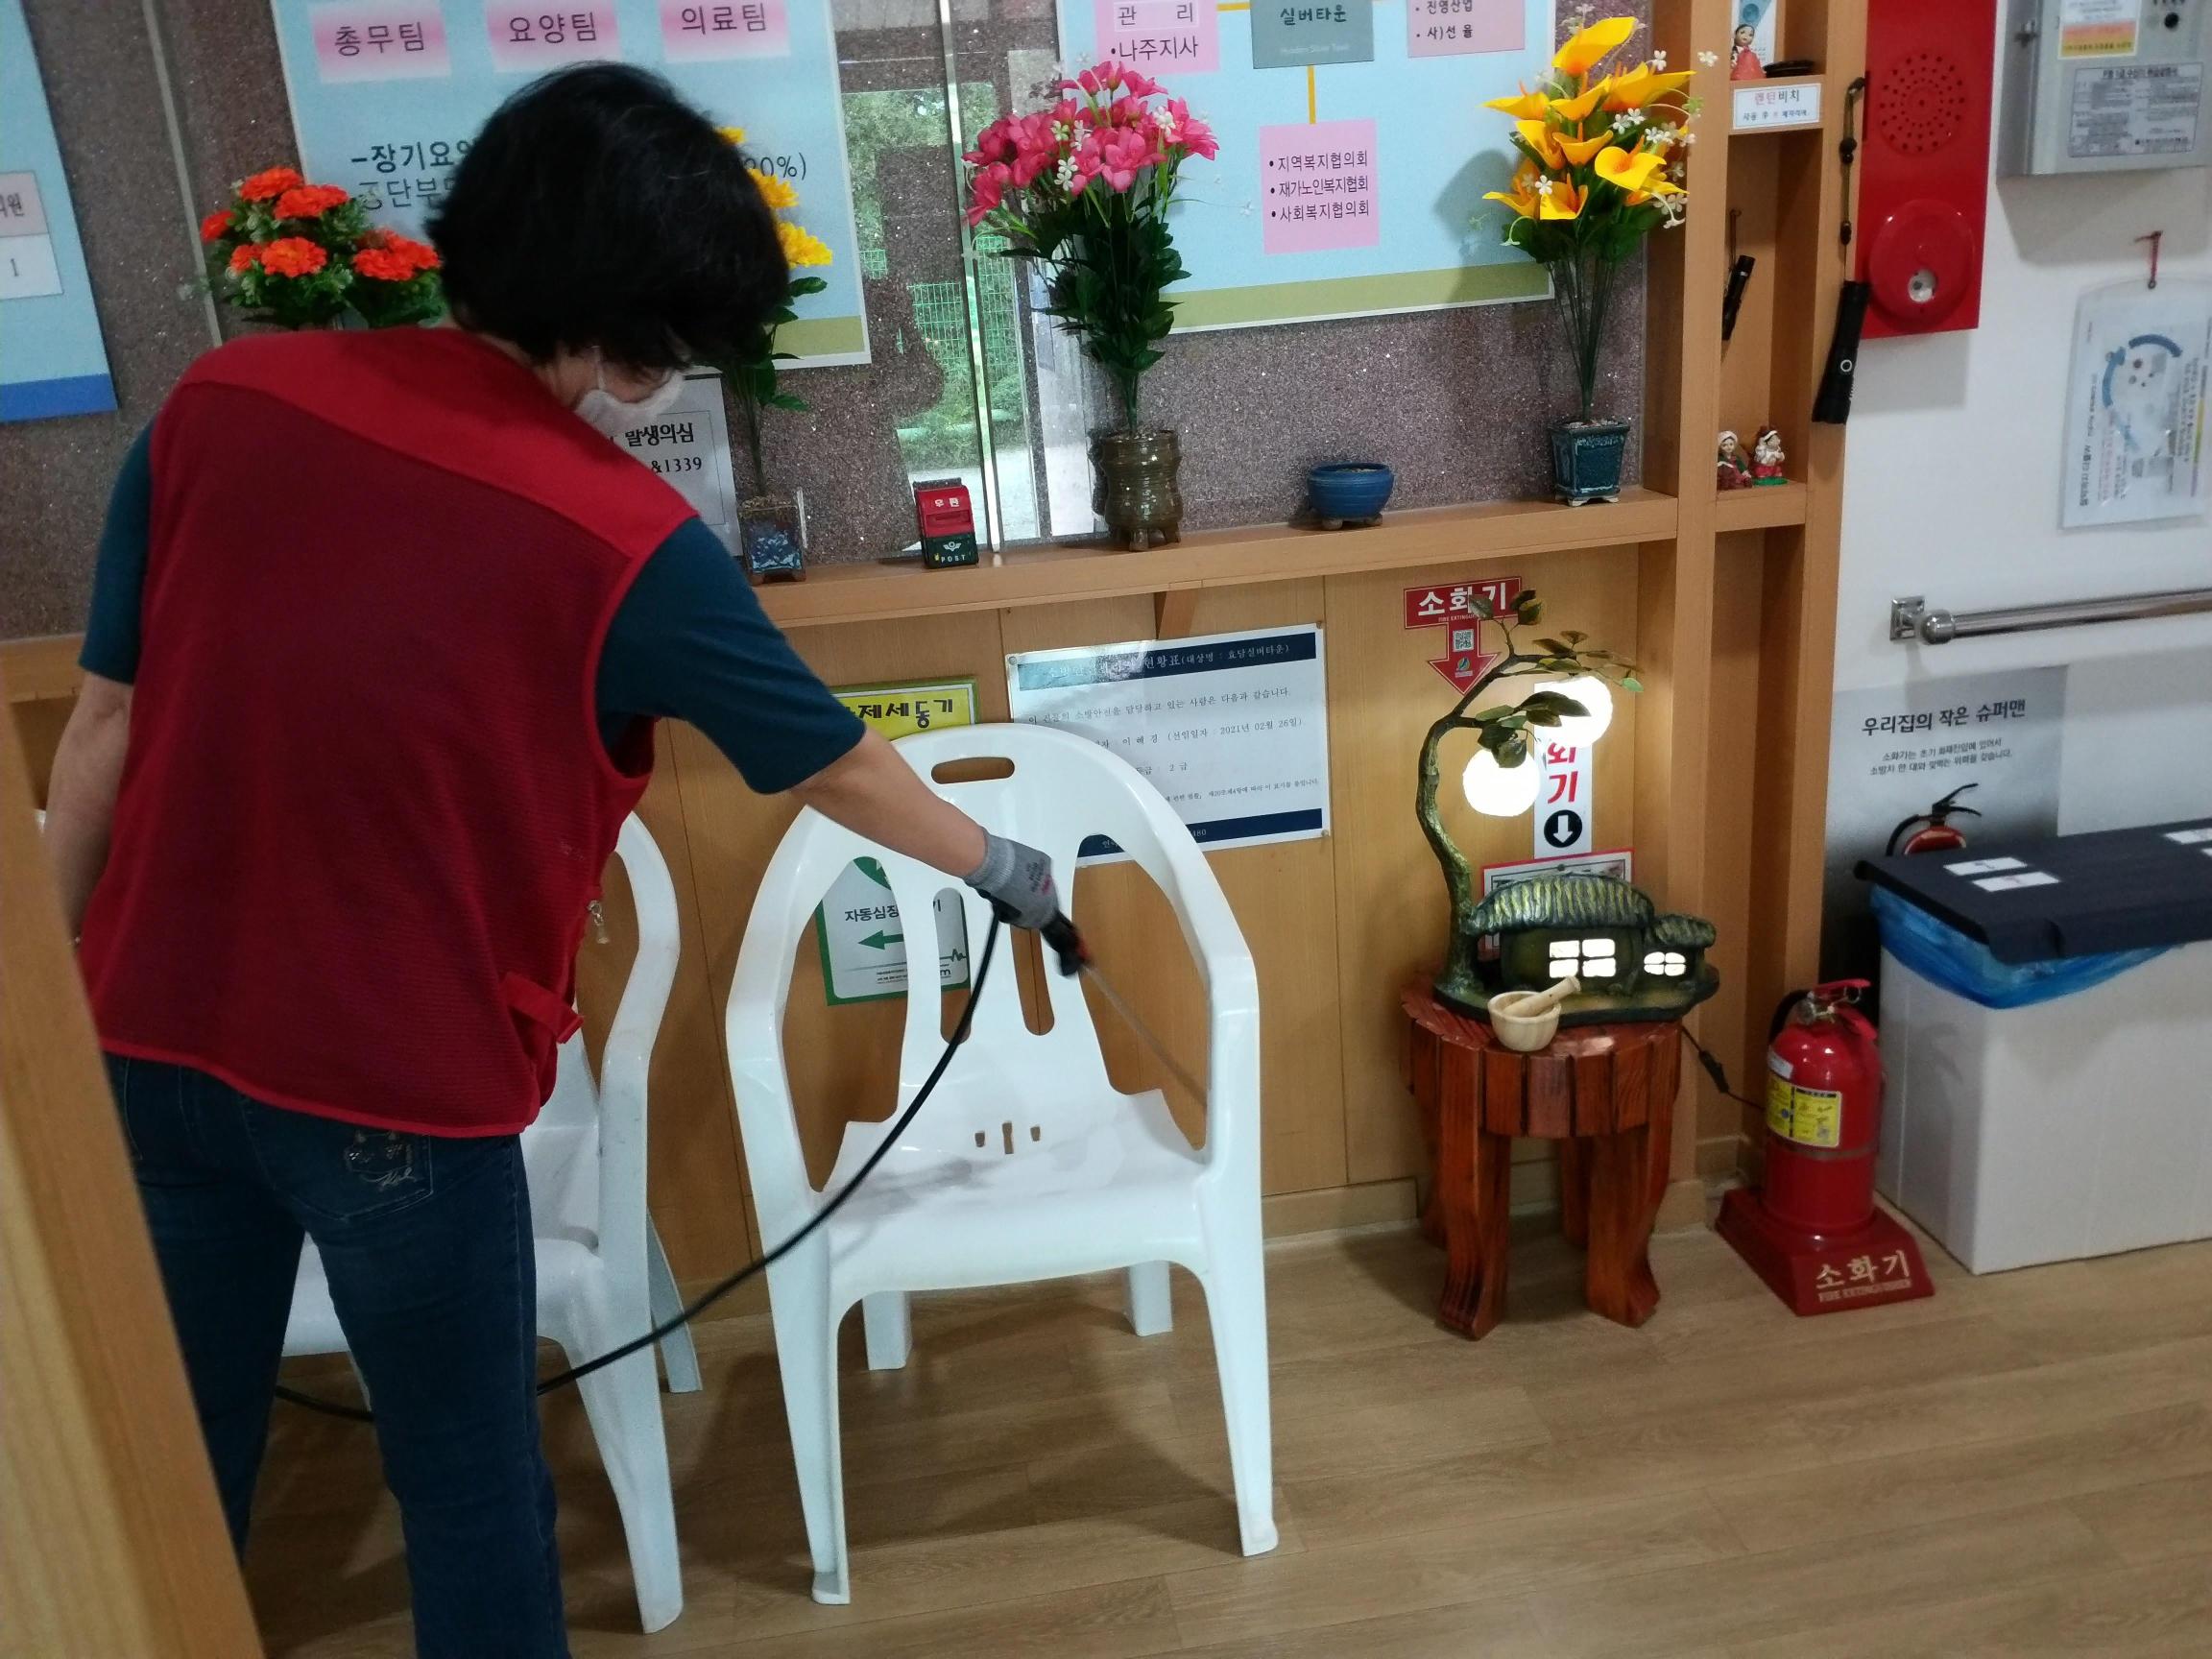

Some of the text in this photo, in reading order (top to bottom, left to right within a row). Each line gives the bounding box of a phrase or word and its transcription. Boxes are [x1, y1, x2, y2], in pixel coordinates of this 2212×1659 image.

[508, 12, 598, 44] 요양팀
[681, 4, 767, 35] 의료팀
[1280, 4, 1347, 26] 실버타운
[334, 21, 425, 57] 총무팀
[1118, 36, 1199, 61] 나주지사
[1278, 150, 1367, 173] 지역복지협의회
[1279, 176, 1368, 198] 재가노인복지협회
[1280, 200, 1369, 223] 사회복지협의회
[1418, 582, 1506, 616] 소화기
[1862, 699, 2026, 736] 우리집의 작은 슈퍼맨
[1816, 1250, 1910, 1289] 소화기
